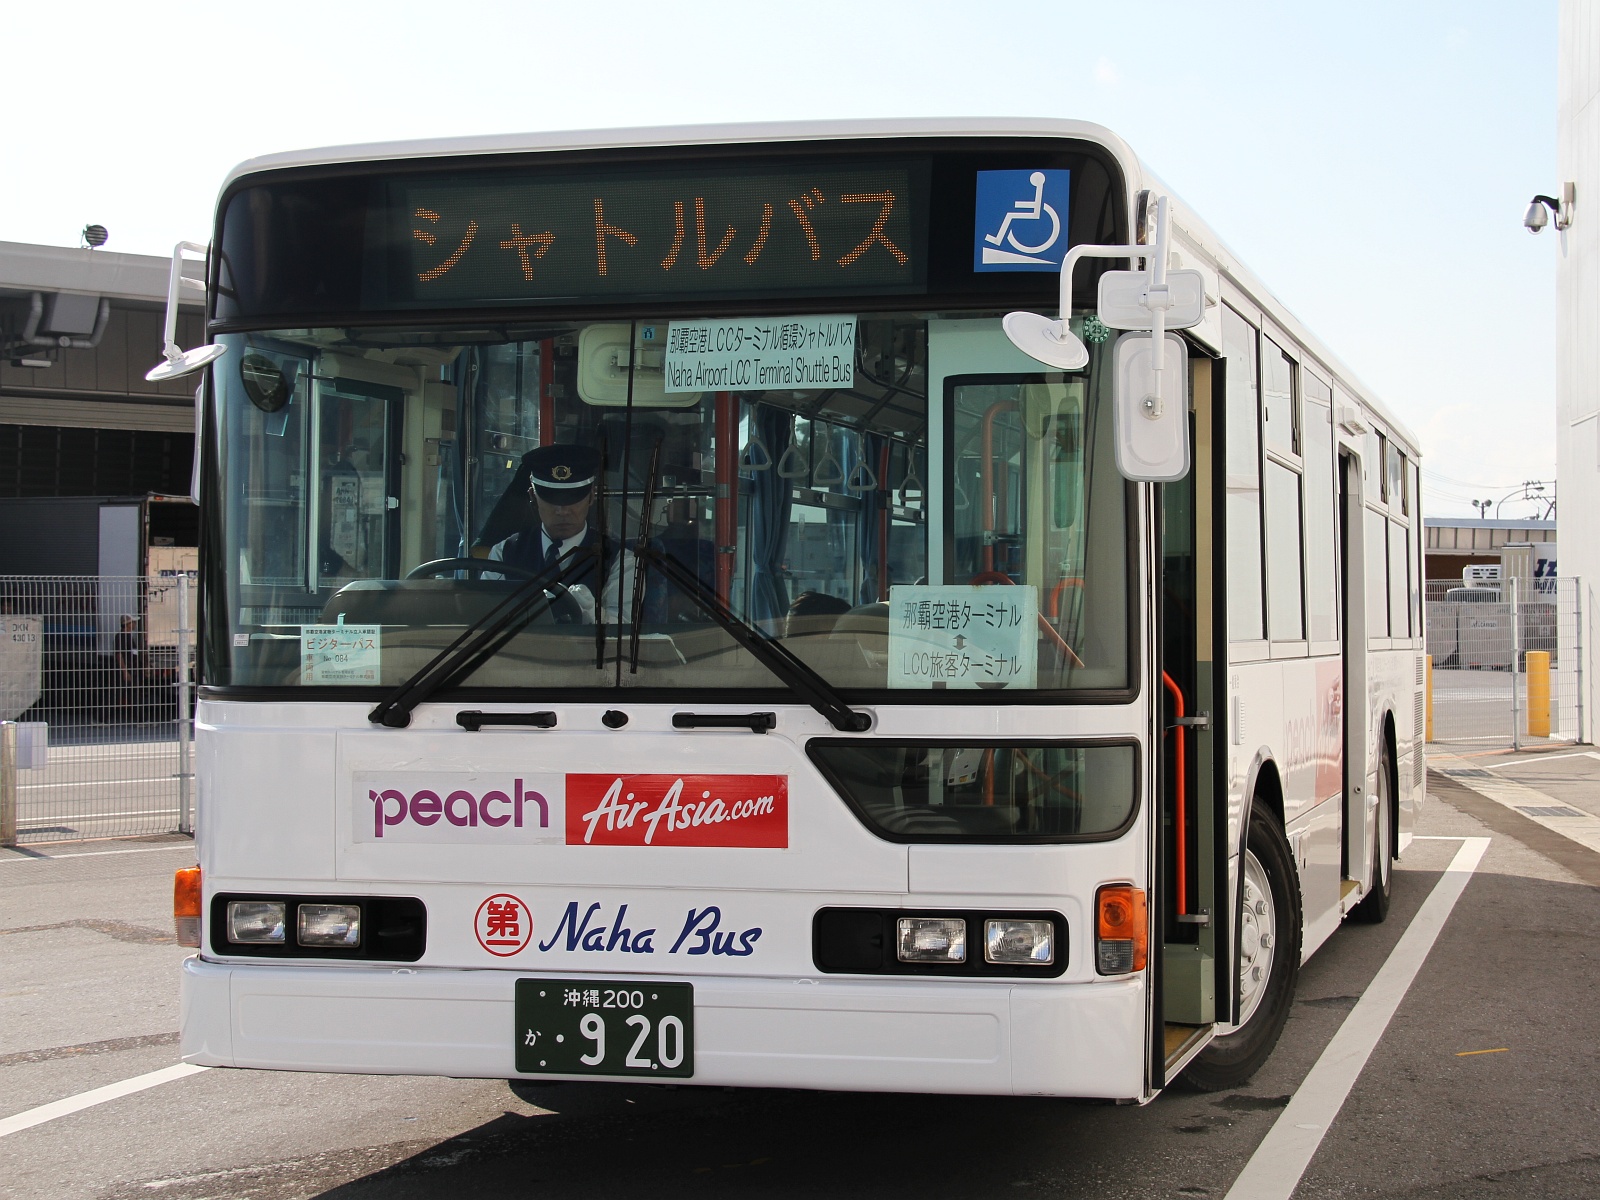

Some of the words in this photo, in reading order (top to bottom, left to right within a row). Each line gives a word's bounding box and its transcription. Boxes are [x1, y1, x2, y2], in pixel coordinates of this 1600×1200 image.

[412, 187, 909, 283] シャトルバス
[669, 322, 853, 354] 那覇空港LCCターミナル循環シャトルバス
[1092, 325, 1102, 334] 25
[668, 361, 692, 387] Naha
[695, 361, 728, 389] Airport
[730, 359, 751, 386] LCC
[754, 357, 794, 384] Terminal
[795, 356, 830, 383] Shuttle
[833, 355, 851, 382] Bus
[903, 599, 1022, 630] 那覇空港ターミナル
[306, 637, 375, 650] ビジターパス
[335, 654, 348, 663] 084
[903, 651, 1022, 679] LCC旅客ターミナル
[368, 778, 549, 838] peach
[538, 901, 657, 953] Naha
[668, 905, 763, 957] Bus
[524, 1028, 542, 1047] か
